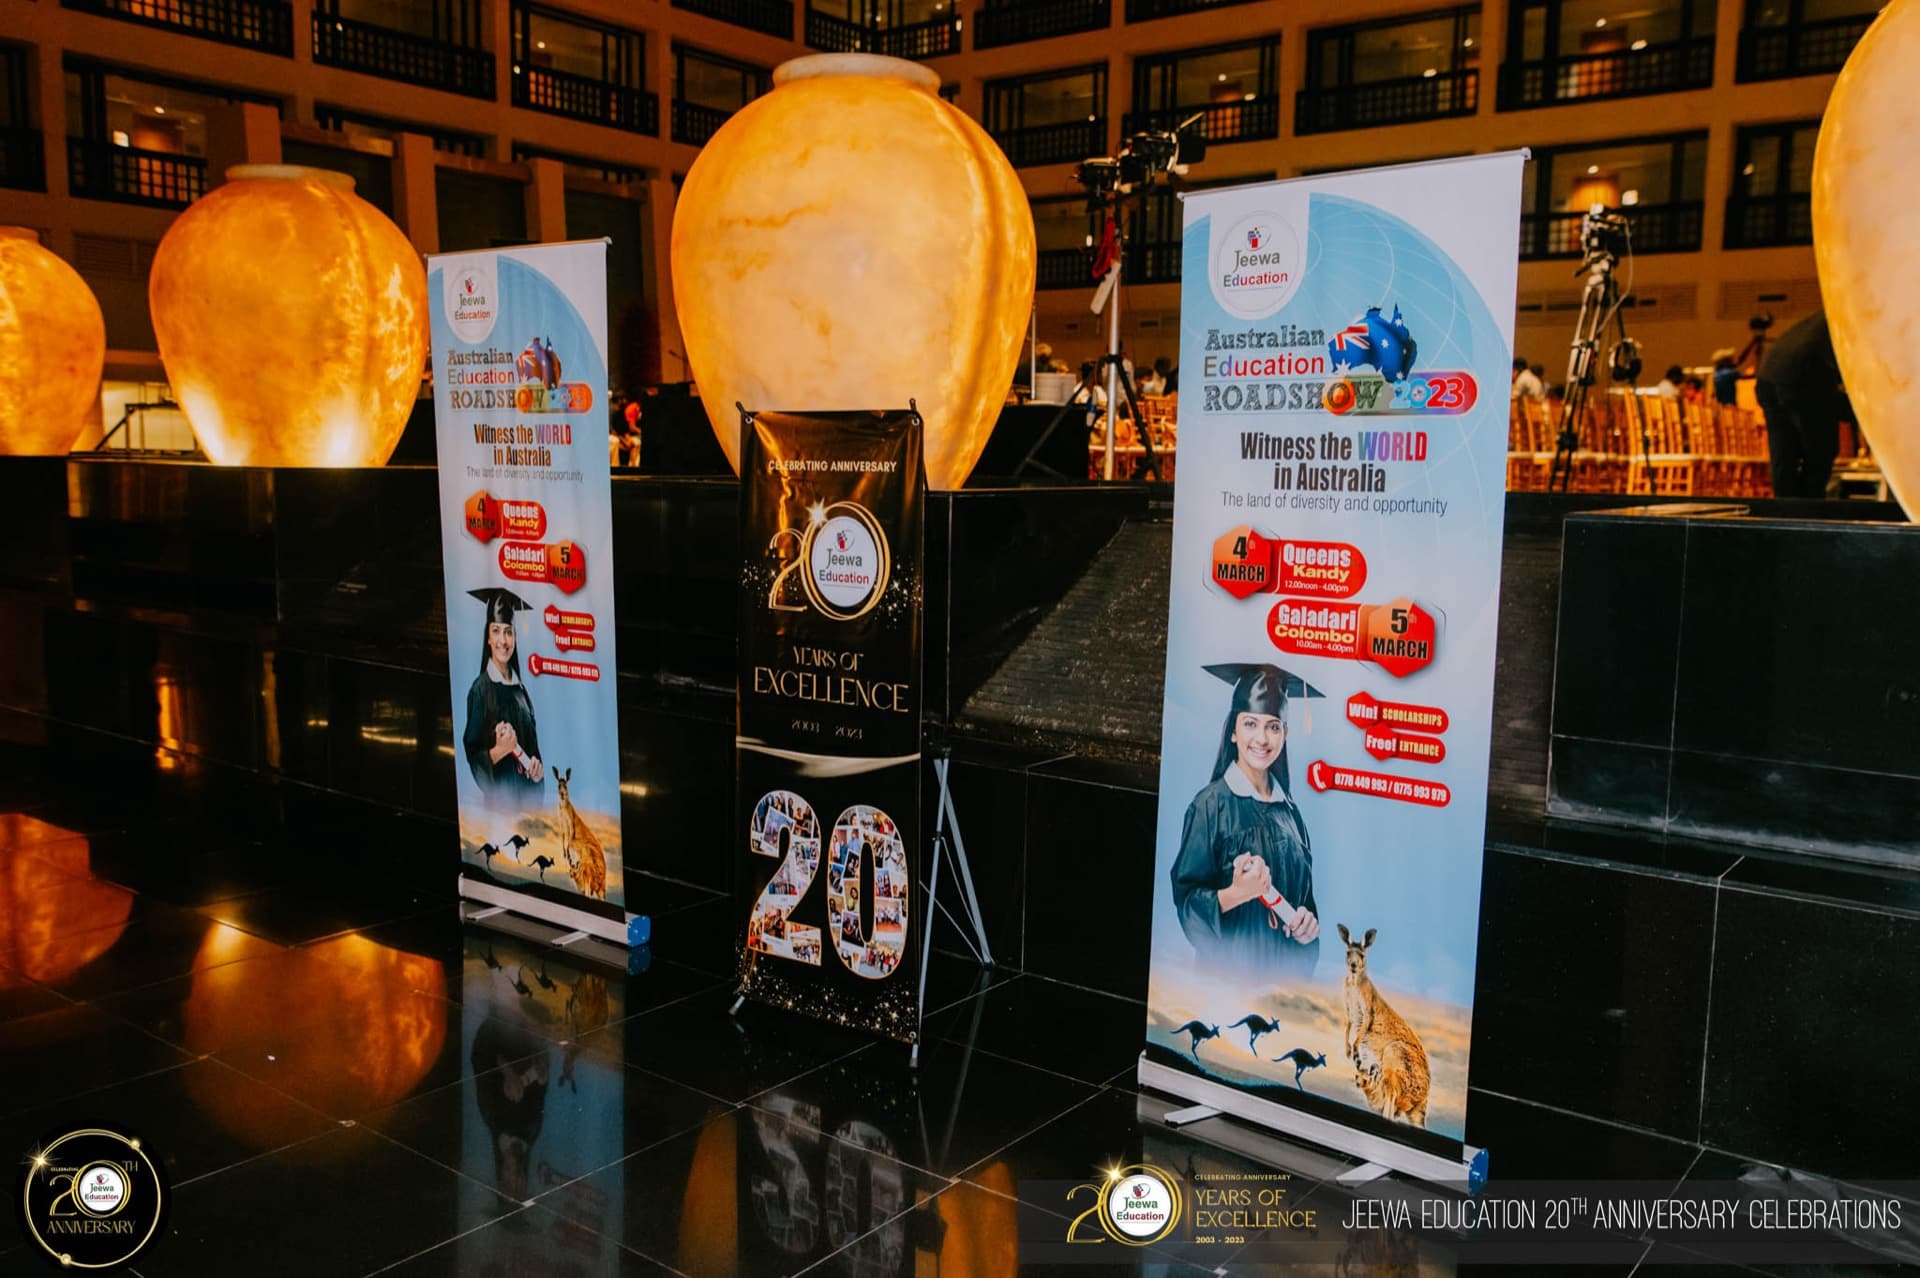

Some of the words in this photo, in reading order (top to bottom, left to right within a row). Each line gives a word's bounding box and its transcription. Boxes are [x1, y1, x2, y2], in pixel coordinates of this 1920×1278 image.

[1233, 250, 1280, 273] Jeewa
[1223, 272, 1288, 288] Education
[459, 294, 485, 310] Jeewa
[455, 311, 490, 321] Education
[1205, 325, 1325, 350] Australian
[447, 348, 513, 365] Australian
[1204, 353, 1324, 378] Education
[447, 368, 515, 384] Education
[449, 388, 545, 409] ROADSHOW
[1203, 379, 1383, 412] ROADSHOW
[1389, 377, 1465, 410] 2023
[474, 424, 514, 444] Witness
[516, 424, 533, 444] the
[536, 424, 571, 444] WORLD
[493, 446, 503, 465] in
[506, 446, 551, 466] Australia
[1241, 432, 1315, 460] Witness
[1320, 432, 1352, 460] the
[1358, 431, 1428, 462] WORLD
[768, 460, 828, 471] CELEBRATING
[830, 461, 897, 473] ANNIVERSARY
[1274, 462, 1292, 490] in
[1296, 462, 1386, 492] Australia
[477, 498, 485, 513] 4
[503, 503, 538, 519] Queens
[1221, 491, 1243, 507] The
[1248, 492, 1271, 508] land
[1275, 493, 1287, 509] of
[1291, 493, 1340, 514] diversity
[1345, 496, 1369, 512] and
[1373, 497, 1448, 518] opportunity
[509, 518, 539, 529] Kandy
[561, 547, 570, 564] 5
[826, 548, 863, 569] Jeewa
[1283, 543, 1351, 567] Queens
[503, 560, 545, 572] Colombo
[1218, 564, 1265, 582] MARCH
[1293, 564, 1350, 583] Kandy
[819, 570, 870, 584] Education
[1323, 583, 1349, 593] 4.00pm
[1278, 604, 1356, 631] Galadari
[1274, 624, 1355, 644] Colombo
[1373, 637, 1427, 659] MARCH
[793, 646, 836, 669] YEARS
[840, 652, 864, 672] OF
[754, 666, 909, 712] EXCELLENCE
[1349, 703, 1378, 720] Win!
[1382, 708, 1442, 727] SCHOLARSHIPS
[1366, 734, 1396, 752] Free!
[1400, 741, 1440, 757] ENTRANCE
[748, 790, 909, 980] 20
